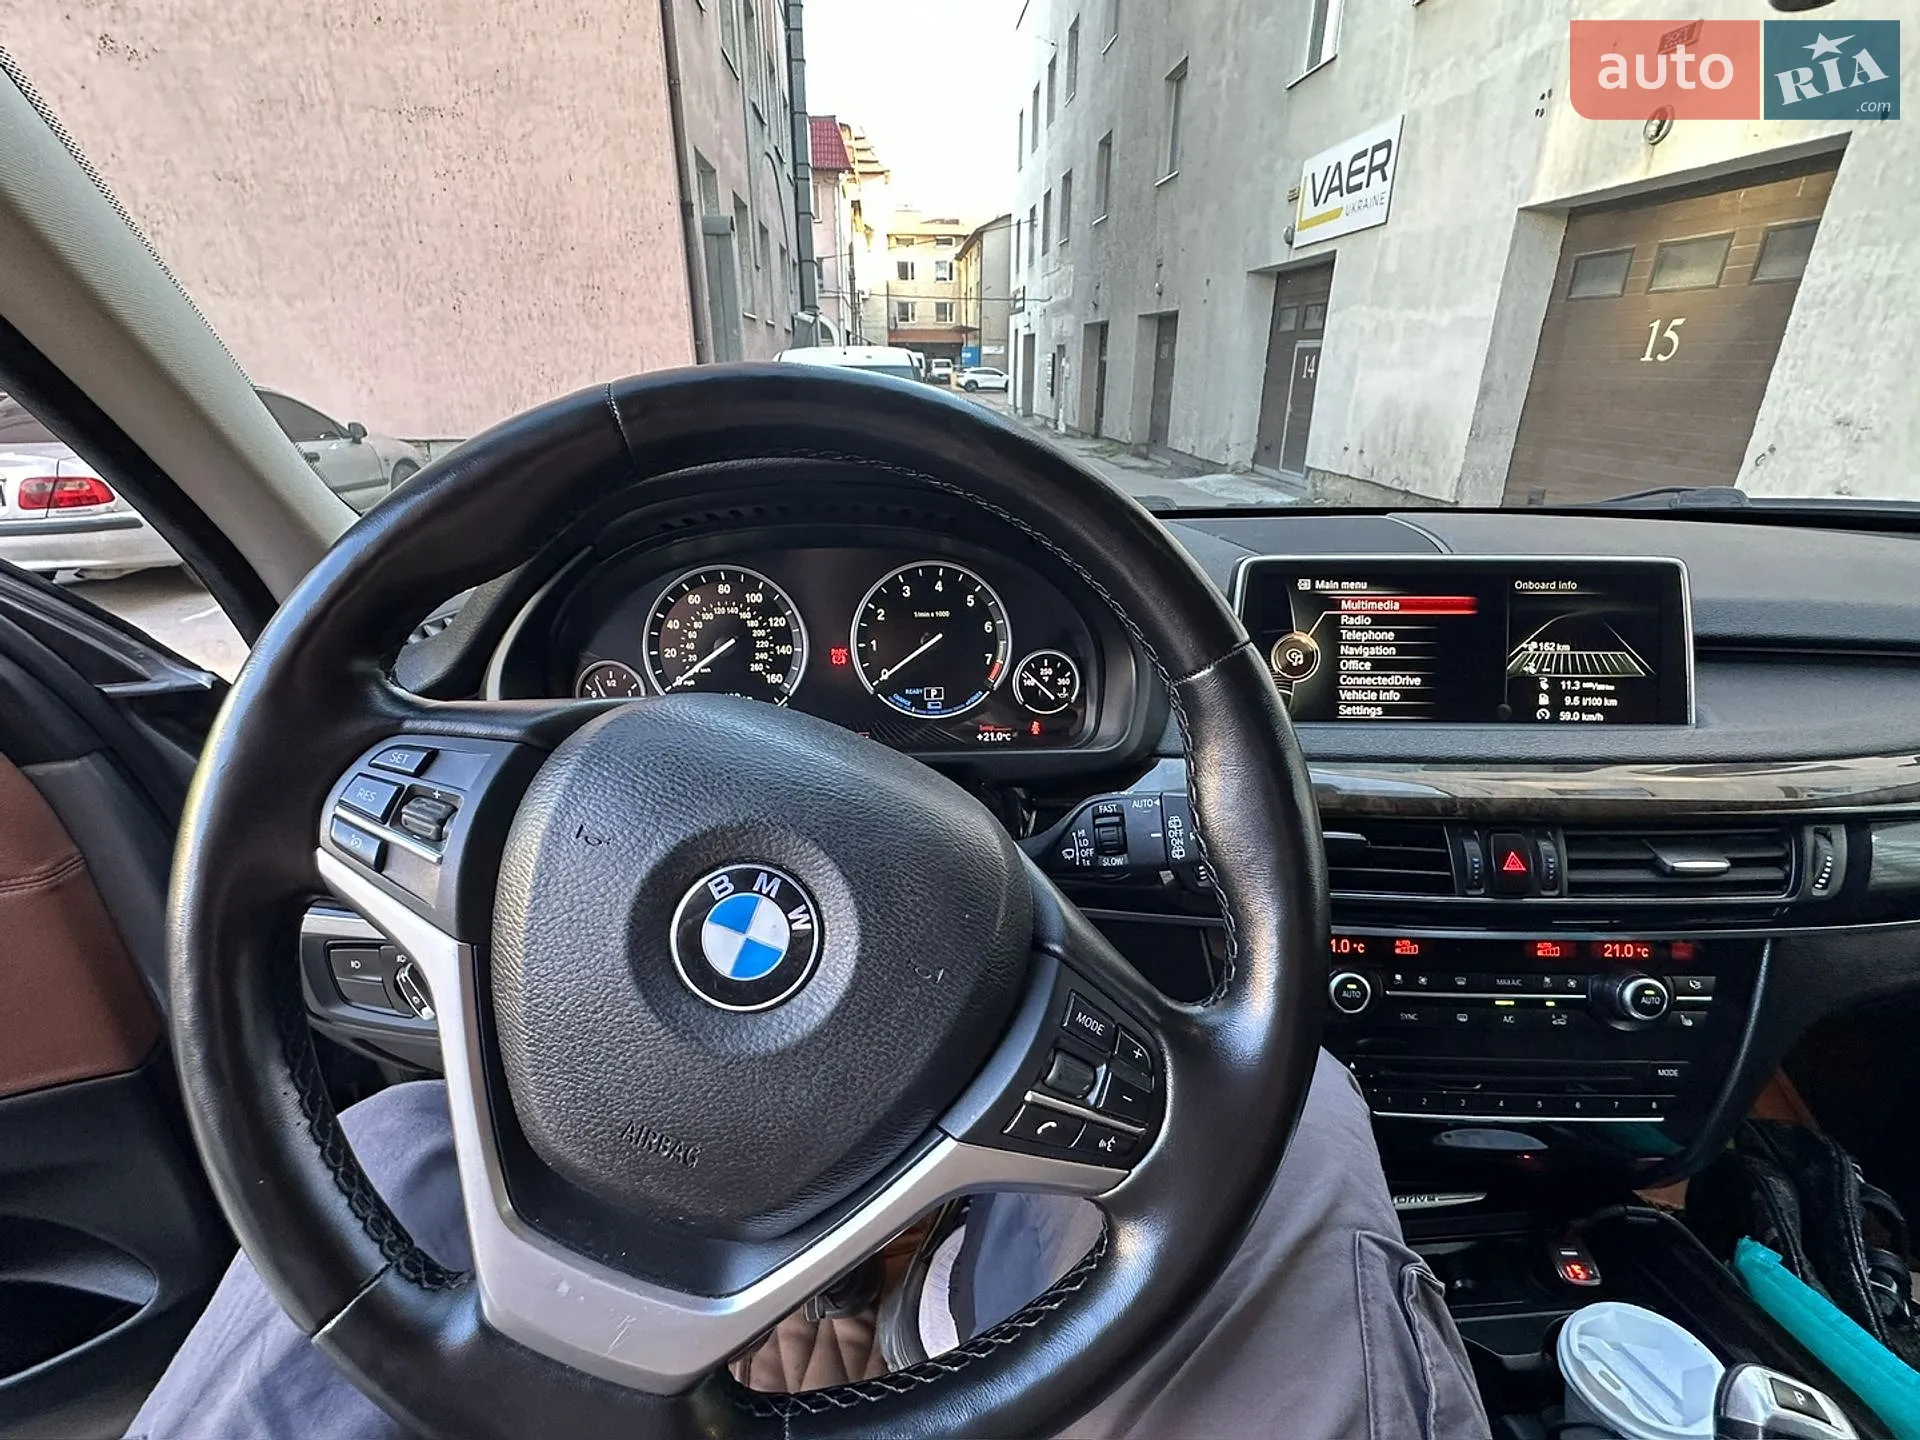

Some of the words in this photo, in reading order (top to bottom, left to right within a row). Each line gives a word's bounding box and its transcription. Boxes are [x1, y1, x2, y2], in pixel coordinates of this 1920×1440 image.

[1311, 139, 1392, 207] VAER
[1345, 191, 1387, 217] UKRAINE
[1640, 318, 1686, 361] 15
[1302, 355, 1316, 379] 14
[717, 584, 731, 594] 80
[934, 581, 943, 592] 4
[1314, 580, 1339, 589] Main
[1341, 581, 1368, 589] menu
[1515, 580, 1556, 590] Onboard
[902, 586, 911, 597] 3
[687, 594, 701, 604] 60
[745, 593, 763, 603] 100
[966, 595, 975, 607] 5
[1341, 600, 1400, 610] Multimedia
[876, 609, 886, 621] 2
[1341, 615, 1371, 625] Radio
[666, 620, 680, 630] 40
[768, 617, 786, 627] 120
[984, 621, 993, 633] 6
[1340, 630, 1395, 641] Telephone
[775, 645, 792, 655] 140
[870, 639, 877, 651] 1
[1557, 642, 1571, 651] km
[664, 648, 677, 658] 20
[1340, 645, 1396, 657] Navigation
[985, 653, 993, 665] 7
[1340, 660, 1371, 670] Office
[766, 674, 783, 684] 160
[1339, 675, 1421, 686] ConnectedDrive
[930, 689, 938, 699] P
[1339, 690, 1378, 701] Vehicle
[1604, 697, 1618, 706] km
[1339, 705, 1383, 717] Settings
[390, 752, 410, 764] SET
[357, 787, 377, 802] RES
[1098, 804, 1117, 813] FAST
[1132, 799, 1153, 809] AUTO
[1168, 828, 1184, 838] OFF
[1079, 838, 1089, 847] LO
[1170, 838, 1184, 848] ON
[1080, 848, 1094, 858] OFF
[1102, 856, 1124, 867] SLOW
[707, 872, 812, 931] BMW
[1603, 944, 1634, 957] 21.0
[1342, 990, 1361, 998] AUTO
[1640, 996, 1661, 1004] AUTO
[1075, 1011, 1105, 1036] MODE
[1658, 1069, 1680, 1077] MODE
[621, 1120, 702, 1168] AIRBAG
[1793, 1390, 1806, 1405] P
